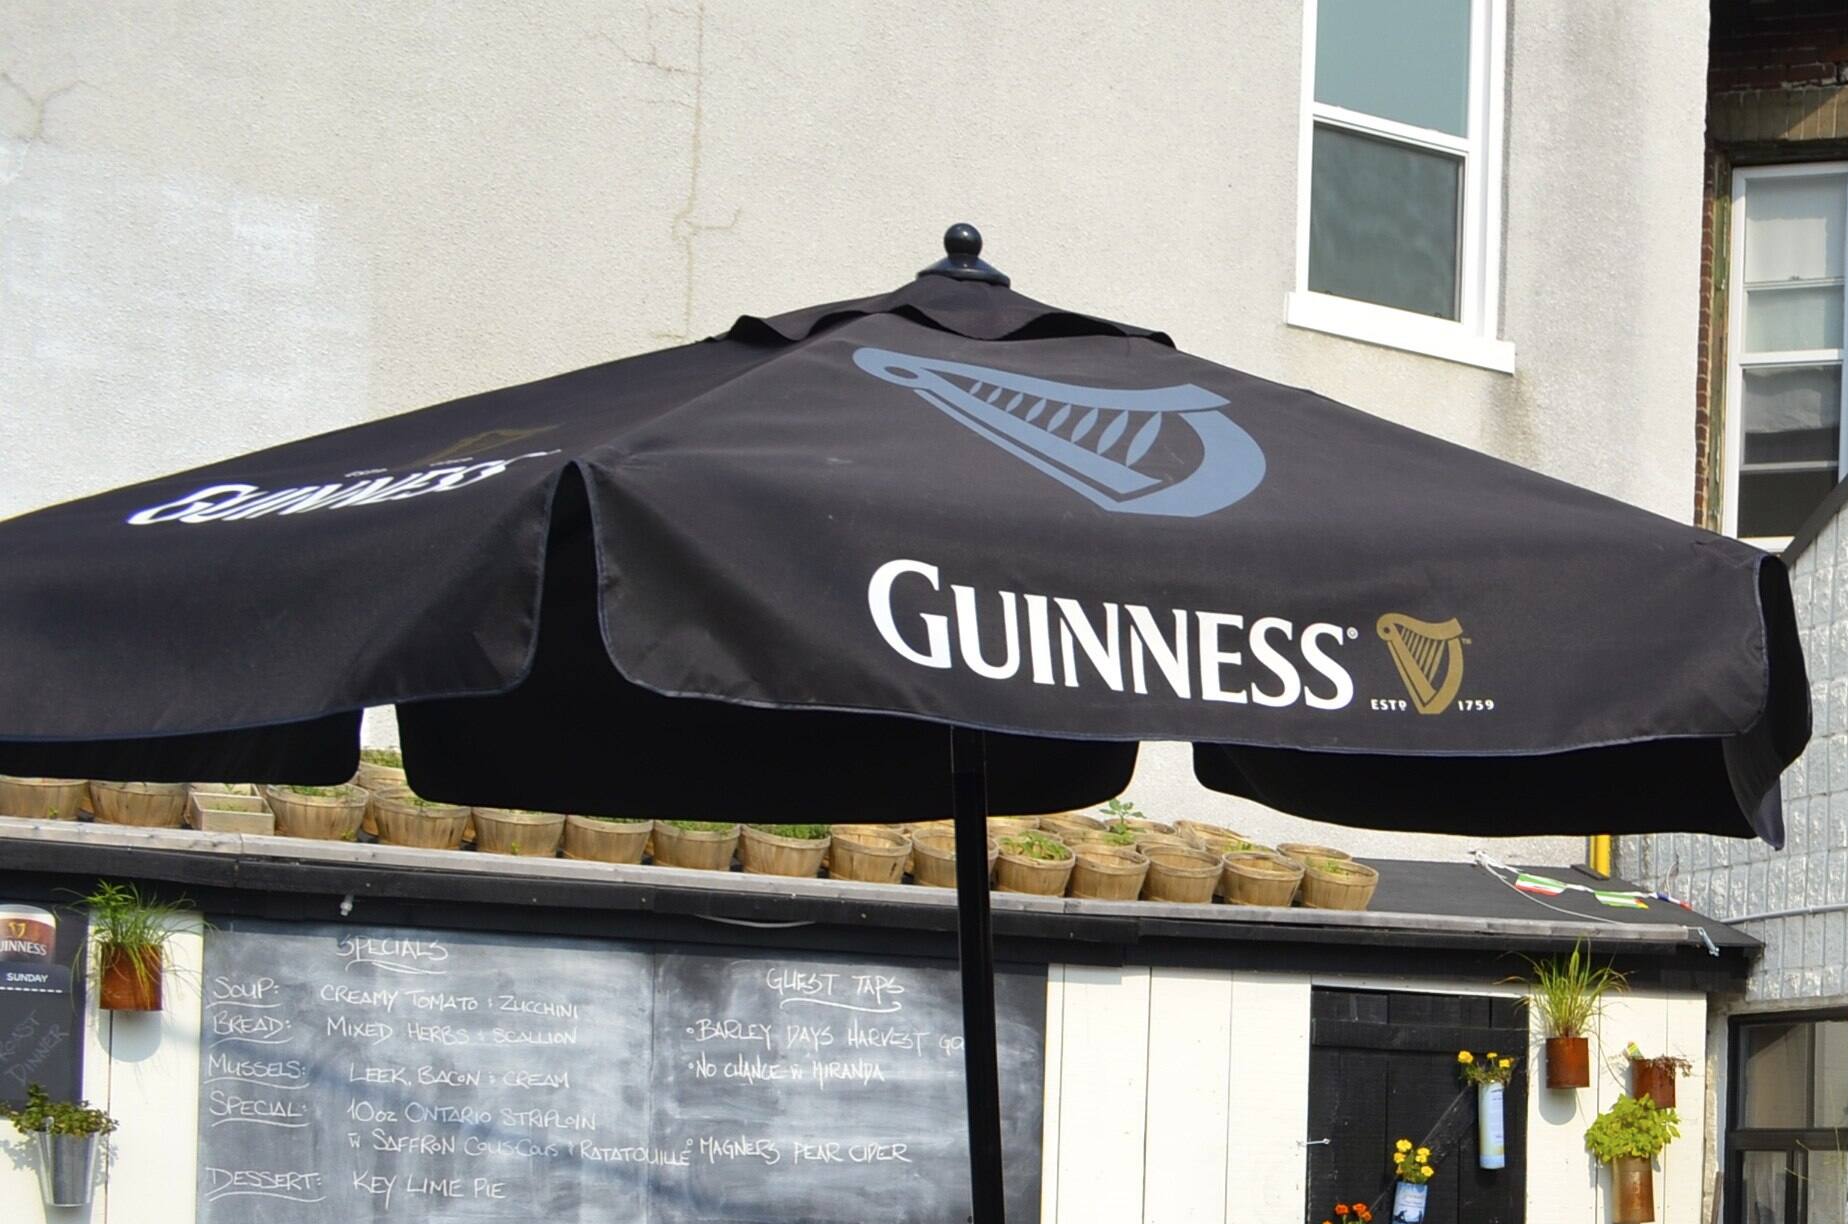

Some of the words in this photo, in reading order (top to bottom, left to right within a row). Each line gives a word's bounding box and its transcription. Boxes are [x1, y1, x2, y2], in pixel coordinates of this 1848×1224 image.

[868, 559, 1356, 710] GUINNESS
[1458, 699, 1495, 711] 1759
[336, 934, 449, 961] SPECIALS
[6, 972, 48, 983] SUNDAY
[766, 967, 840, 996] GUEST
[852, 974, 904, 1004] TAPS
[320, 984, 398, 1013] CREAMY
[405, 990, 478, 1011] TOMATO
[500, 995, 578, 1019] ZUCCHINI
[327, 1016, 393, 1045] MIXED
[407, 1022, 470, 1045] HERBS
[492, 1026, 577, 1045] SCALLION
[696, 1018, 771, 1050] BARLEY
[787, 1025, 834, 1051] DAYS
[848, 1018, 930, 1056] HARVEST
[4, 1024, 70, 1087] DINNER
[696, 1052, 716, 1078] NO
[724, 1053, 779, 1085] CHANCE
[813, 1059, 885, 1090] MIRANDA
[350, 1063, 412, 1087] LEEK,
[418, 1065, 480, 1087] BACON
[503, 1071, 569, 1089] CREAM
[404, 1102, 491, 1126] ONTARIO
[503, 1108, 596, 1130] STRIPLOIN
[373, 1128, 455, 1155] SAFFRON
[580, 1139, 690, 1167] RATATOUILLE
[700, 1134, 780, 1165] MAGNERS
[794, 1142, 843, 1164] PEAR
[849, 1142, 913, 1164] CIDER
[353, 1170, 397, 1209] KEY
[407, 1174, 464, 1198] LIME
[474, 1176, 506, 1199] PIE
